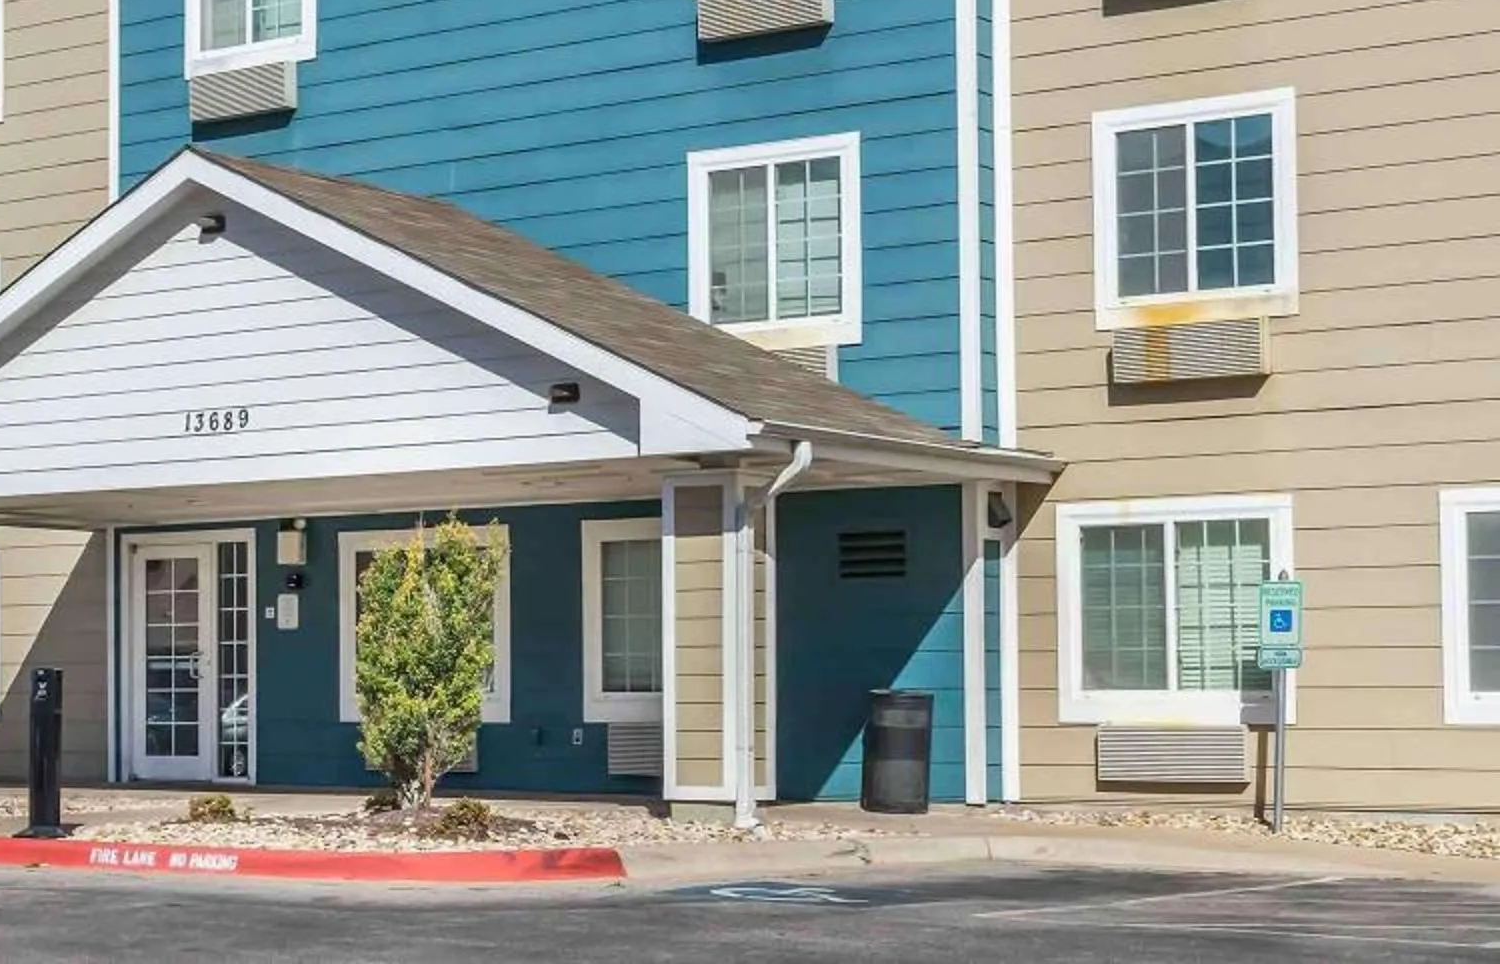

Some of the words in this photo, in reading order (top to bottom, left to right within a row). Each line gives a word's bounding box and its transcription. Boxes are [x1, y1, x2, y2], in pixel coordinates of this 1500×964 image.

[184, 409, 249, 432] 13689
[89, 848, 118, 864] FIRE
[123, 850, 157, 866] LANE
[168, 852, 187, 867] NO
[189, 853, 238, 870] PARKING
